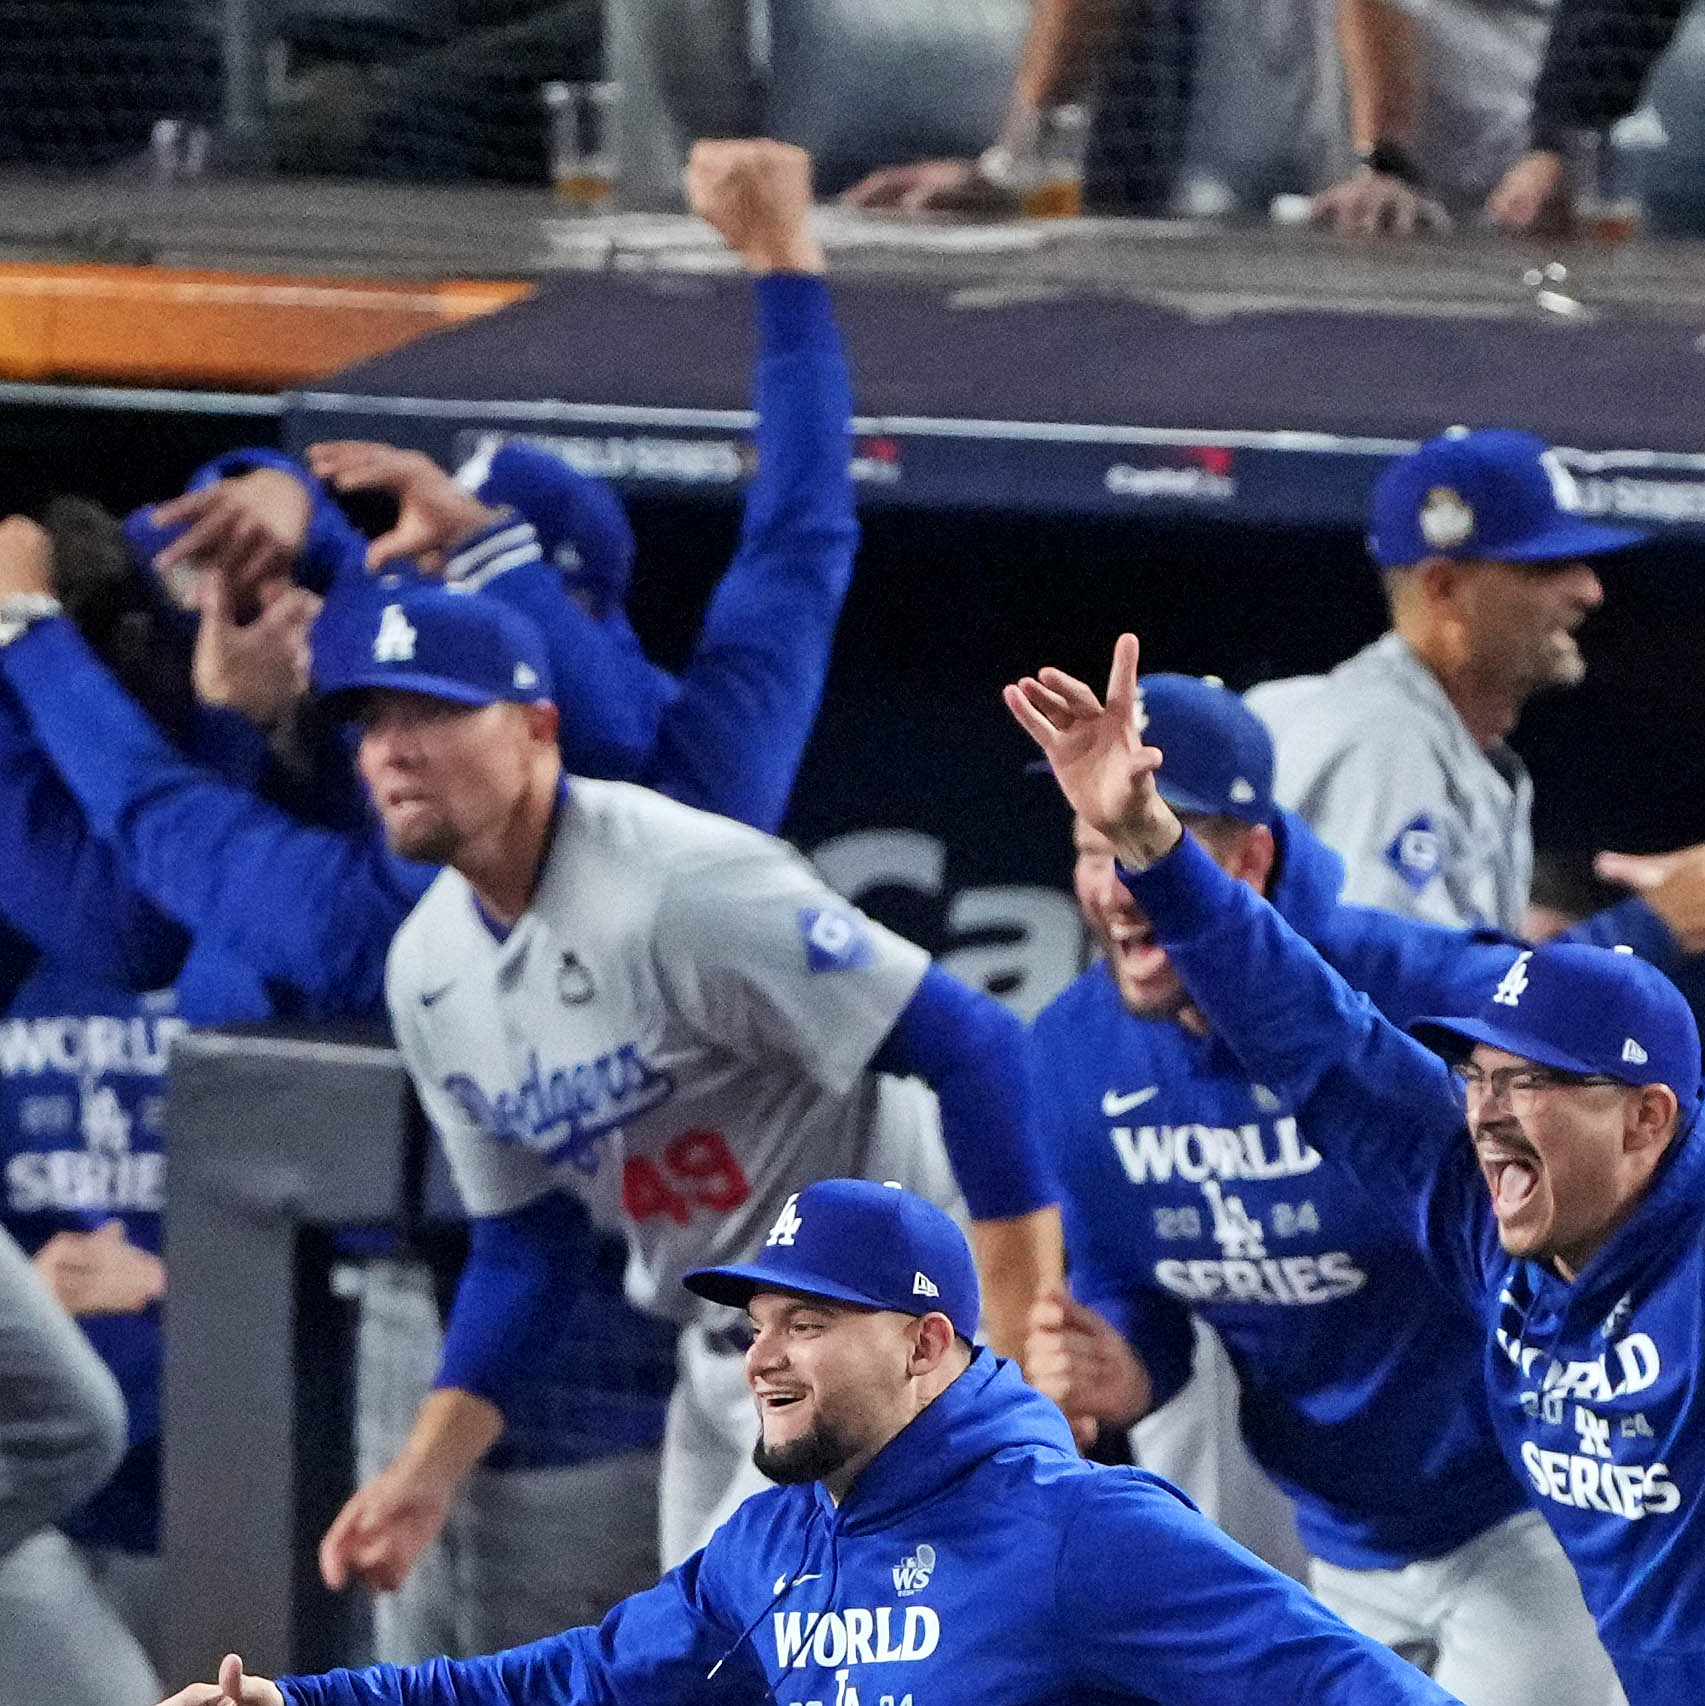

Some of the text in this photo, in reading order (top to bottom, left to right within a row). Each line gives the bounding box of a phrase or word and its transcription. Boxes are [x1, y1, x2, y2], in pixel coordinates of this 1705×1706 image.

[622, 1125, 752, 1224] 49
[1521, 1441, 1681, 1521] SERIES
[892, 1567, 932, 1591] WS
[773, 1605, 941, 1668] WORLD
